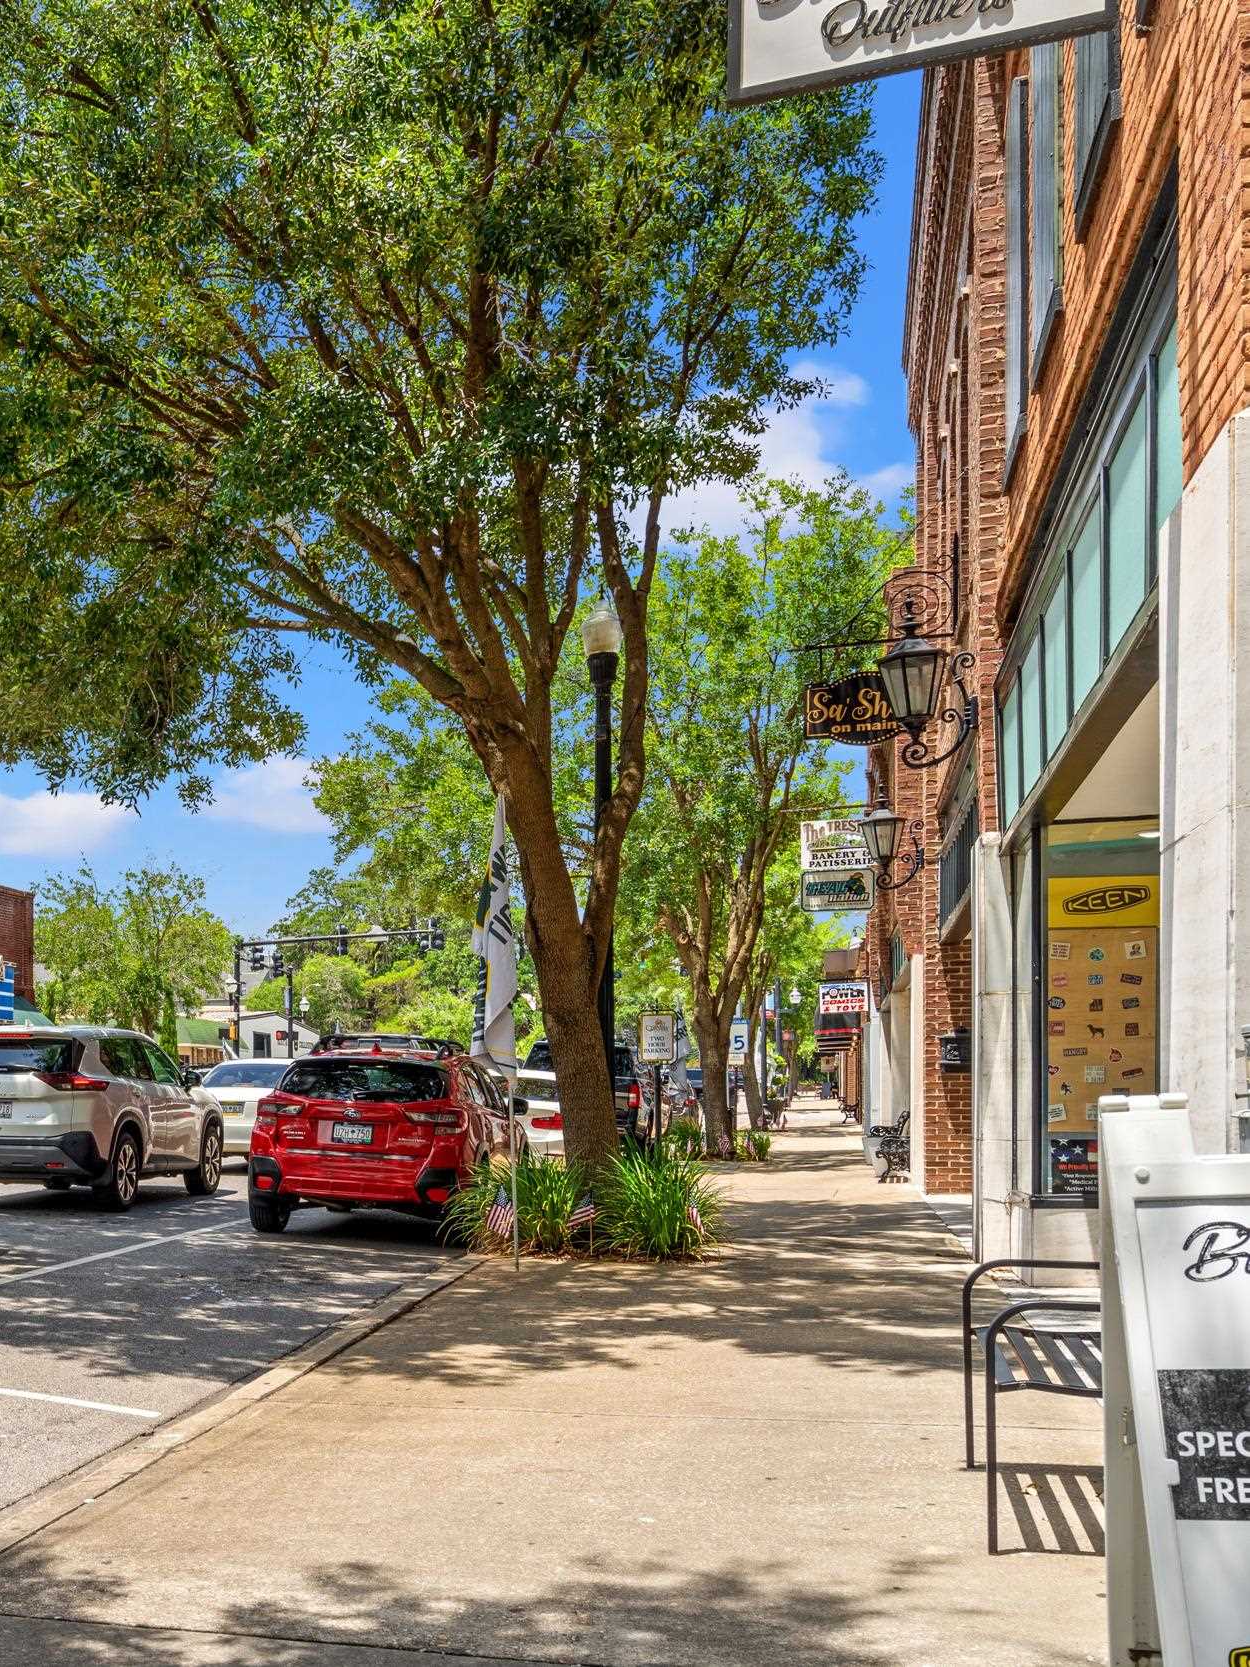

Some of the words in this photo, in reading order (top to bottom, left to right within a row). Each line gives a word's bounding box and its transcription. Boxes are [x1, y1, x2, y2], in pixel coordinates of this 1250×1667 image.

[831, 724, 851, 733] on
[856, 721, 897, 732] main
[803, 823, 826, 842] The
[811, 850, 857, 860] BAKERY
[809, 858, 874, 867] PATISSERIE
[1067, 889, 1146, 911] KEEN
[821, 987, 865, 999] POWER
[734, 1035, 745, 1050] 5
[1183, 1222, 1250, 1282] B
